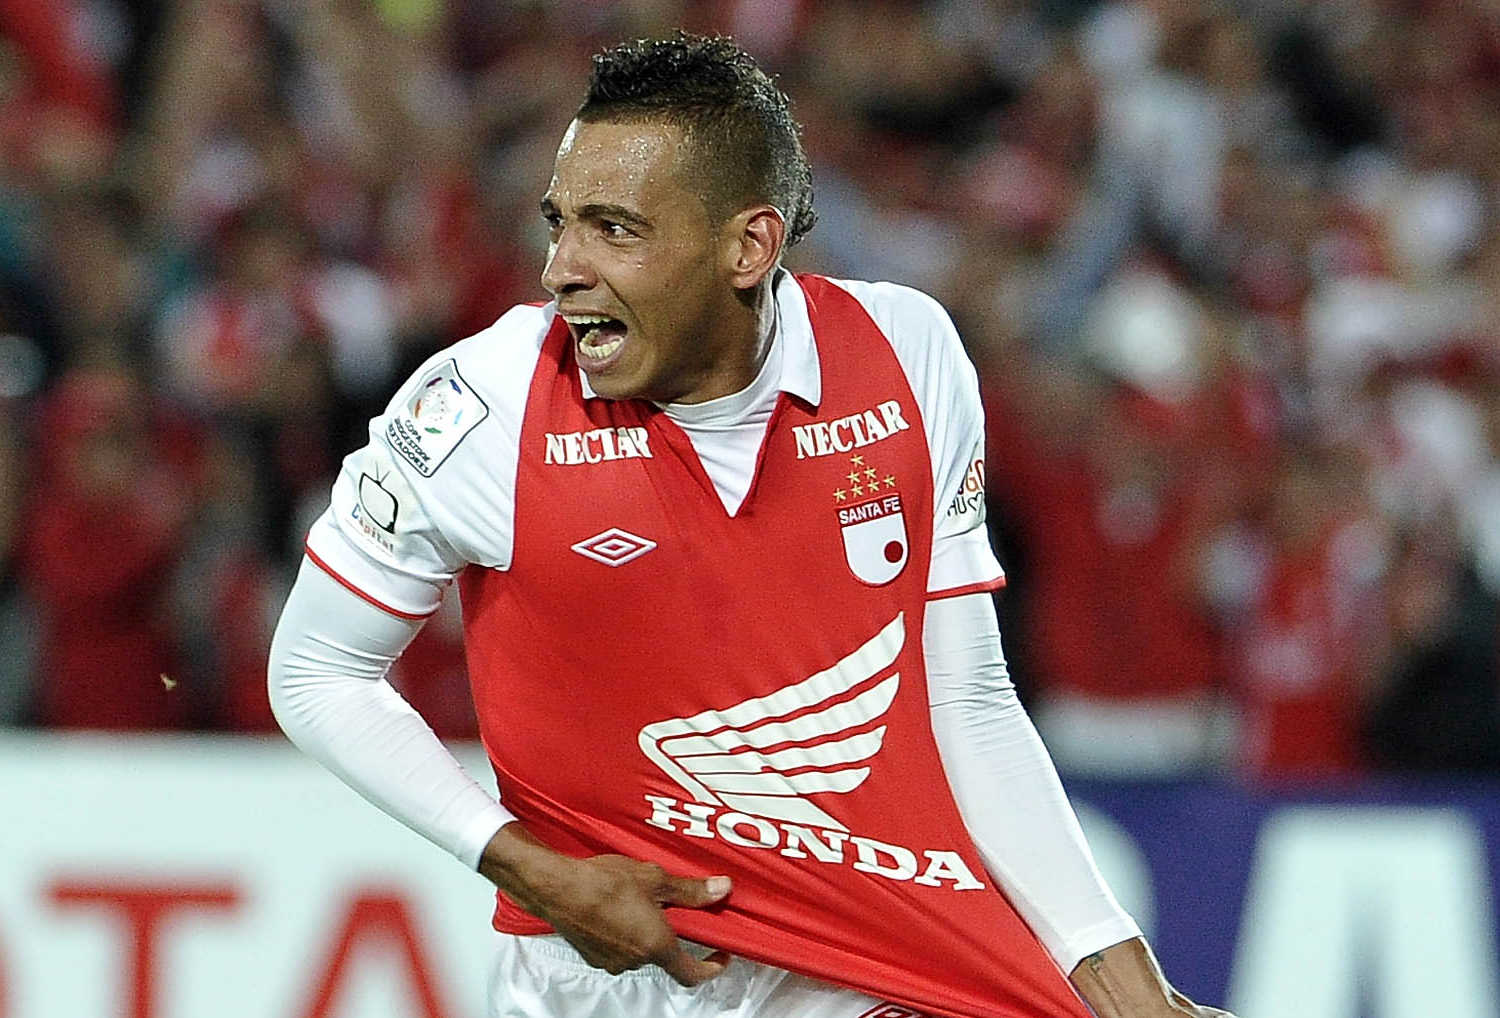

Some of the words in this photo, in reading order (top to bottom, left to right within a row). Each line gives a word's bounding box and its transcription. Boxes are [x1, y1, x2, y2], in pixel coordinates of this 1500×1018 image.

[543, 426, 654, 465] NECTAR
[791, 399, 910, 460] NECTAR
[838, 501, 883, 525] SANTA
[882, 496, 902, 513] FE
[644, 793, 986, 892] HONDA
